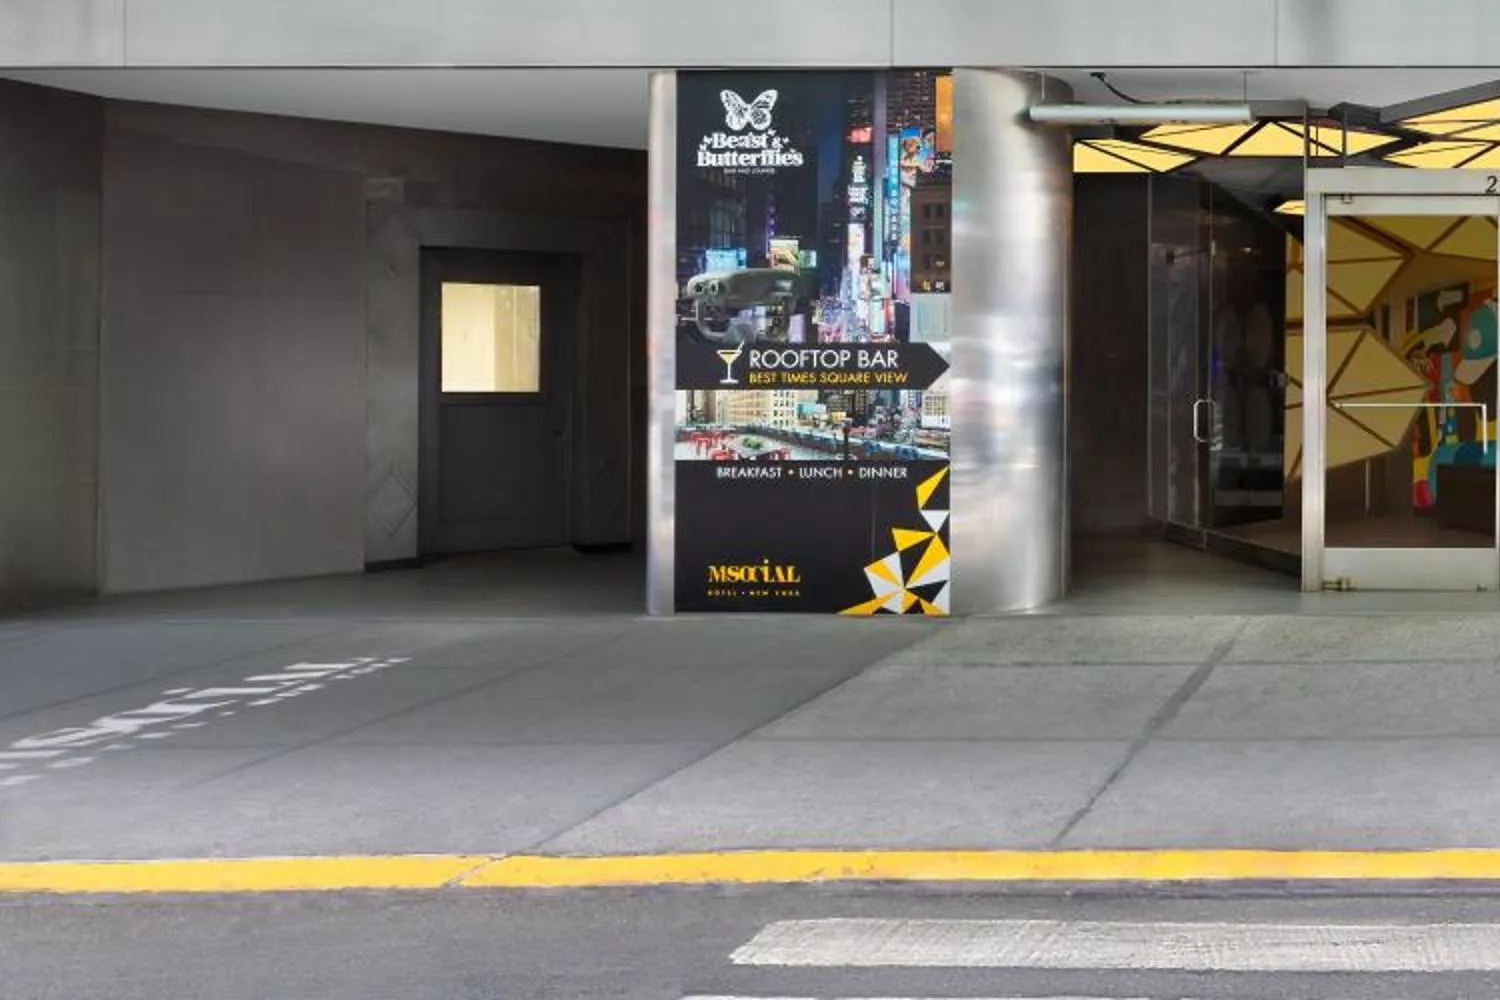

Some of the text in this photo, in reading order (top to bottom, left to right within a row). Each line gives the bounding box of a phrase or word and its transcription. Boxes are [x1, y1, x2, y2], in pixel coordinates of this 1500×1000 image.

[711, 132, 784, 149] Beast &
[696, 149, 805, 167] Butterflies
[749, 349, 899, 369] ROOFTOP BAR
[749, 371, 908, 385] BEST TIMES SQUARE VIEW
[716, 466, 908, 479] BREAKFAST LUNCH DINNER
